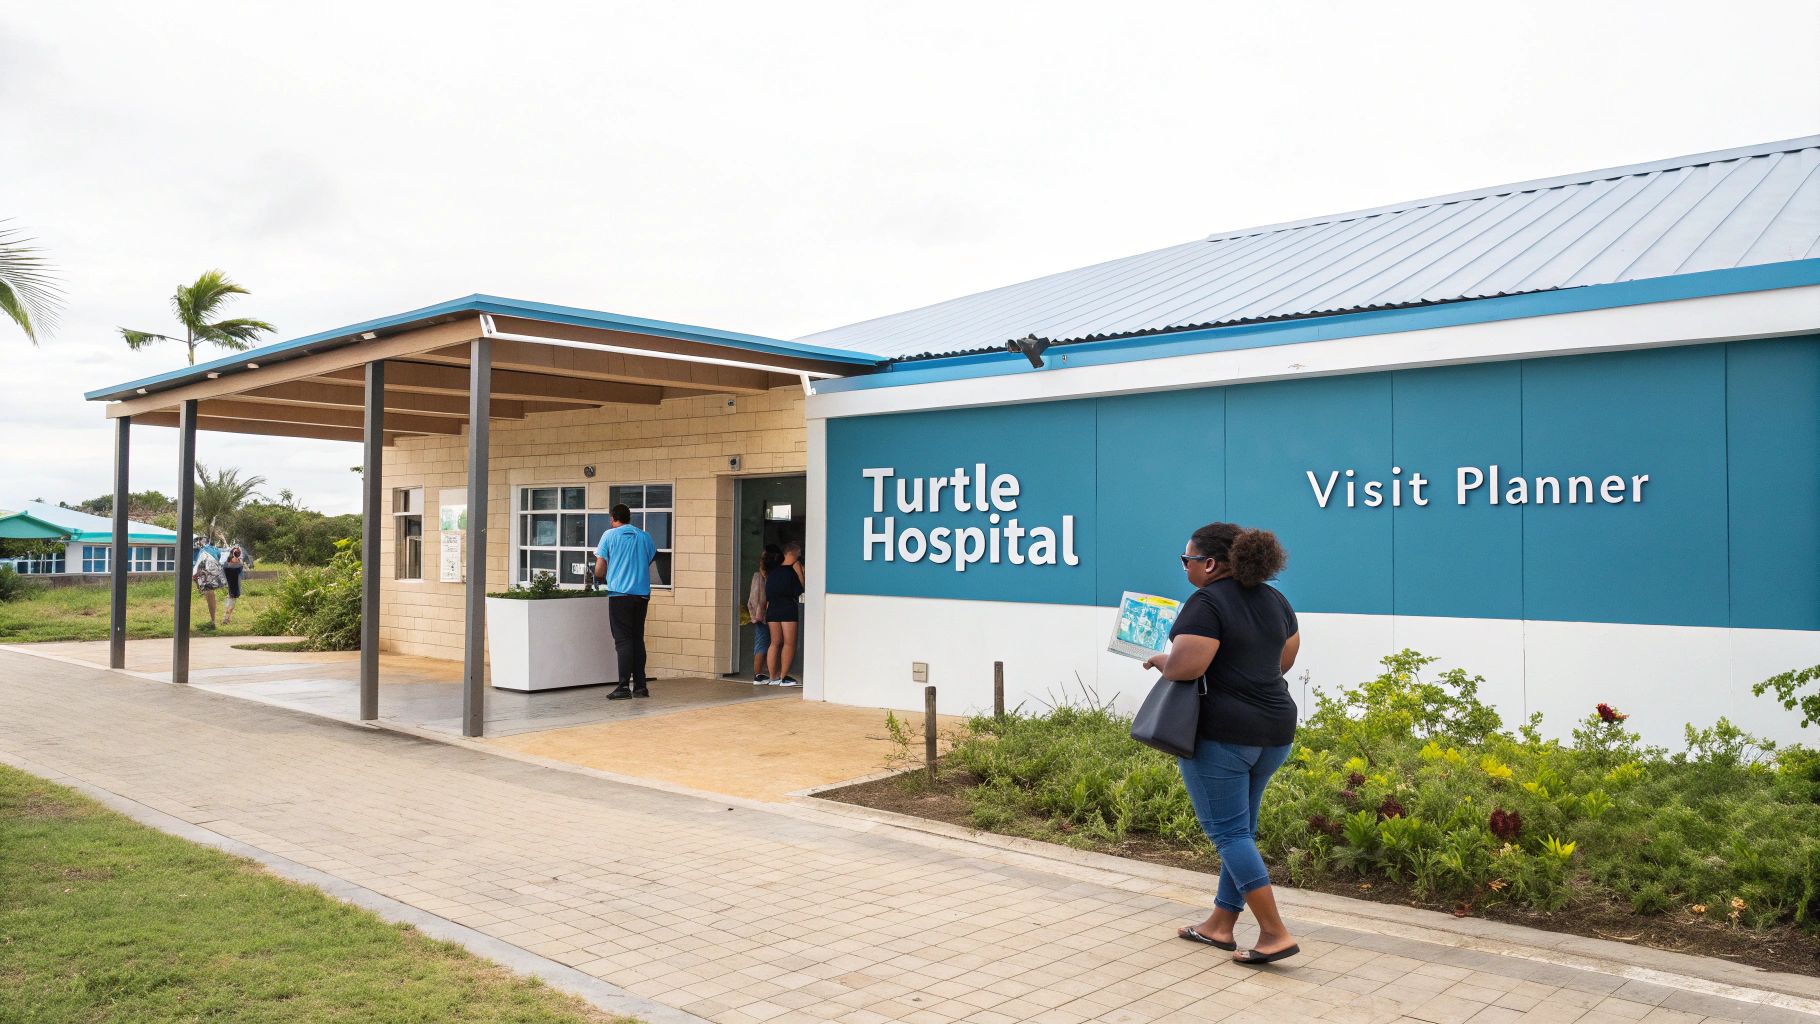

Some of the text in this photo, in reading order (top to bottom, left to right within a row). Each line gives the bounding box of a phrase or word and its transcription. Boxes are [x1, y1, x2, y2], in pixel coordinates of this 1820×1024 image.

[862, 463, 1020, 513] Turtle
[1306, 464, 1650, 508] Visit Planner
[863, 514, 1079, 572] Hospital
